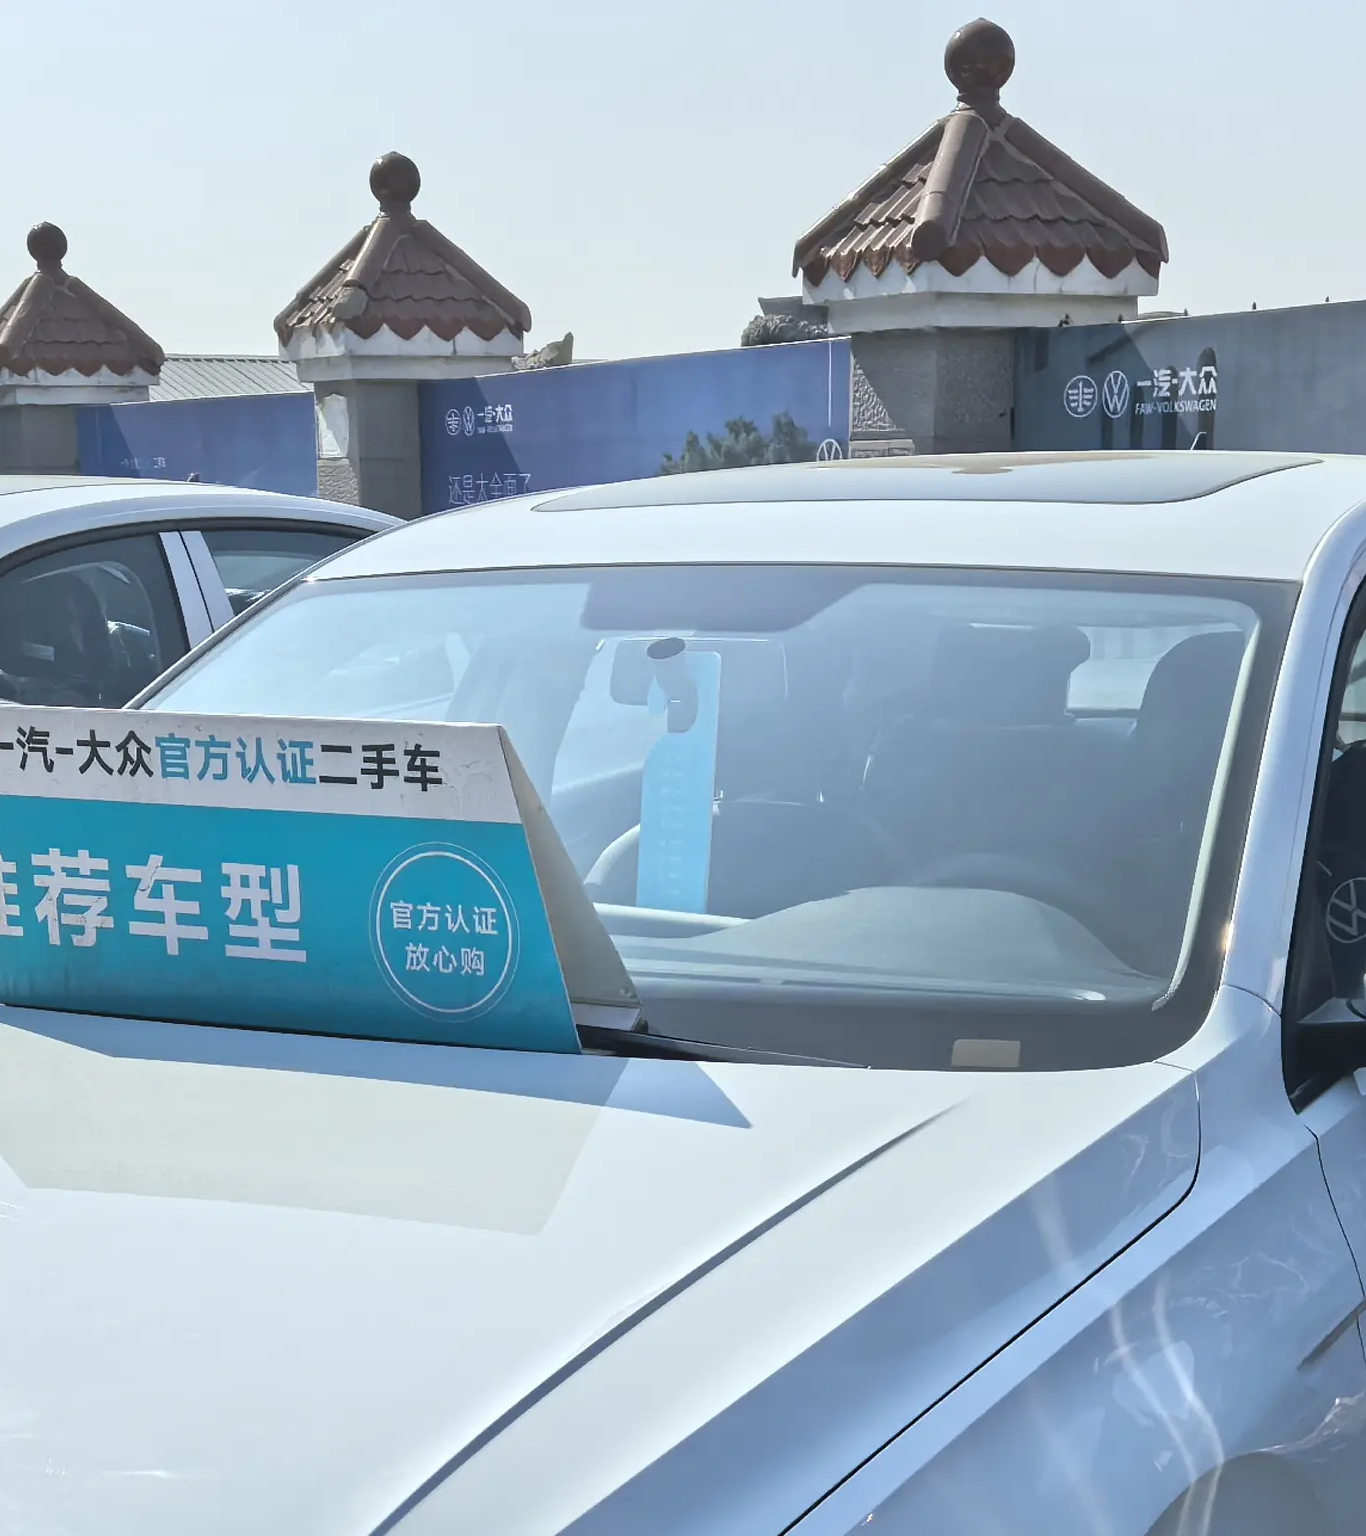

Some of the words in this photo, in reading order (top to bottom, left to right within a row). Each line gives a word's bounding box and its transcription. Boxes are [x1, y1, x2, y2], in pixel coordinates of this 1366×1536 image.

[390, 900, 499, 936] 官方认证
[405, 942, 485, 976] 放心购
